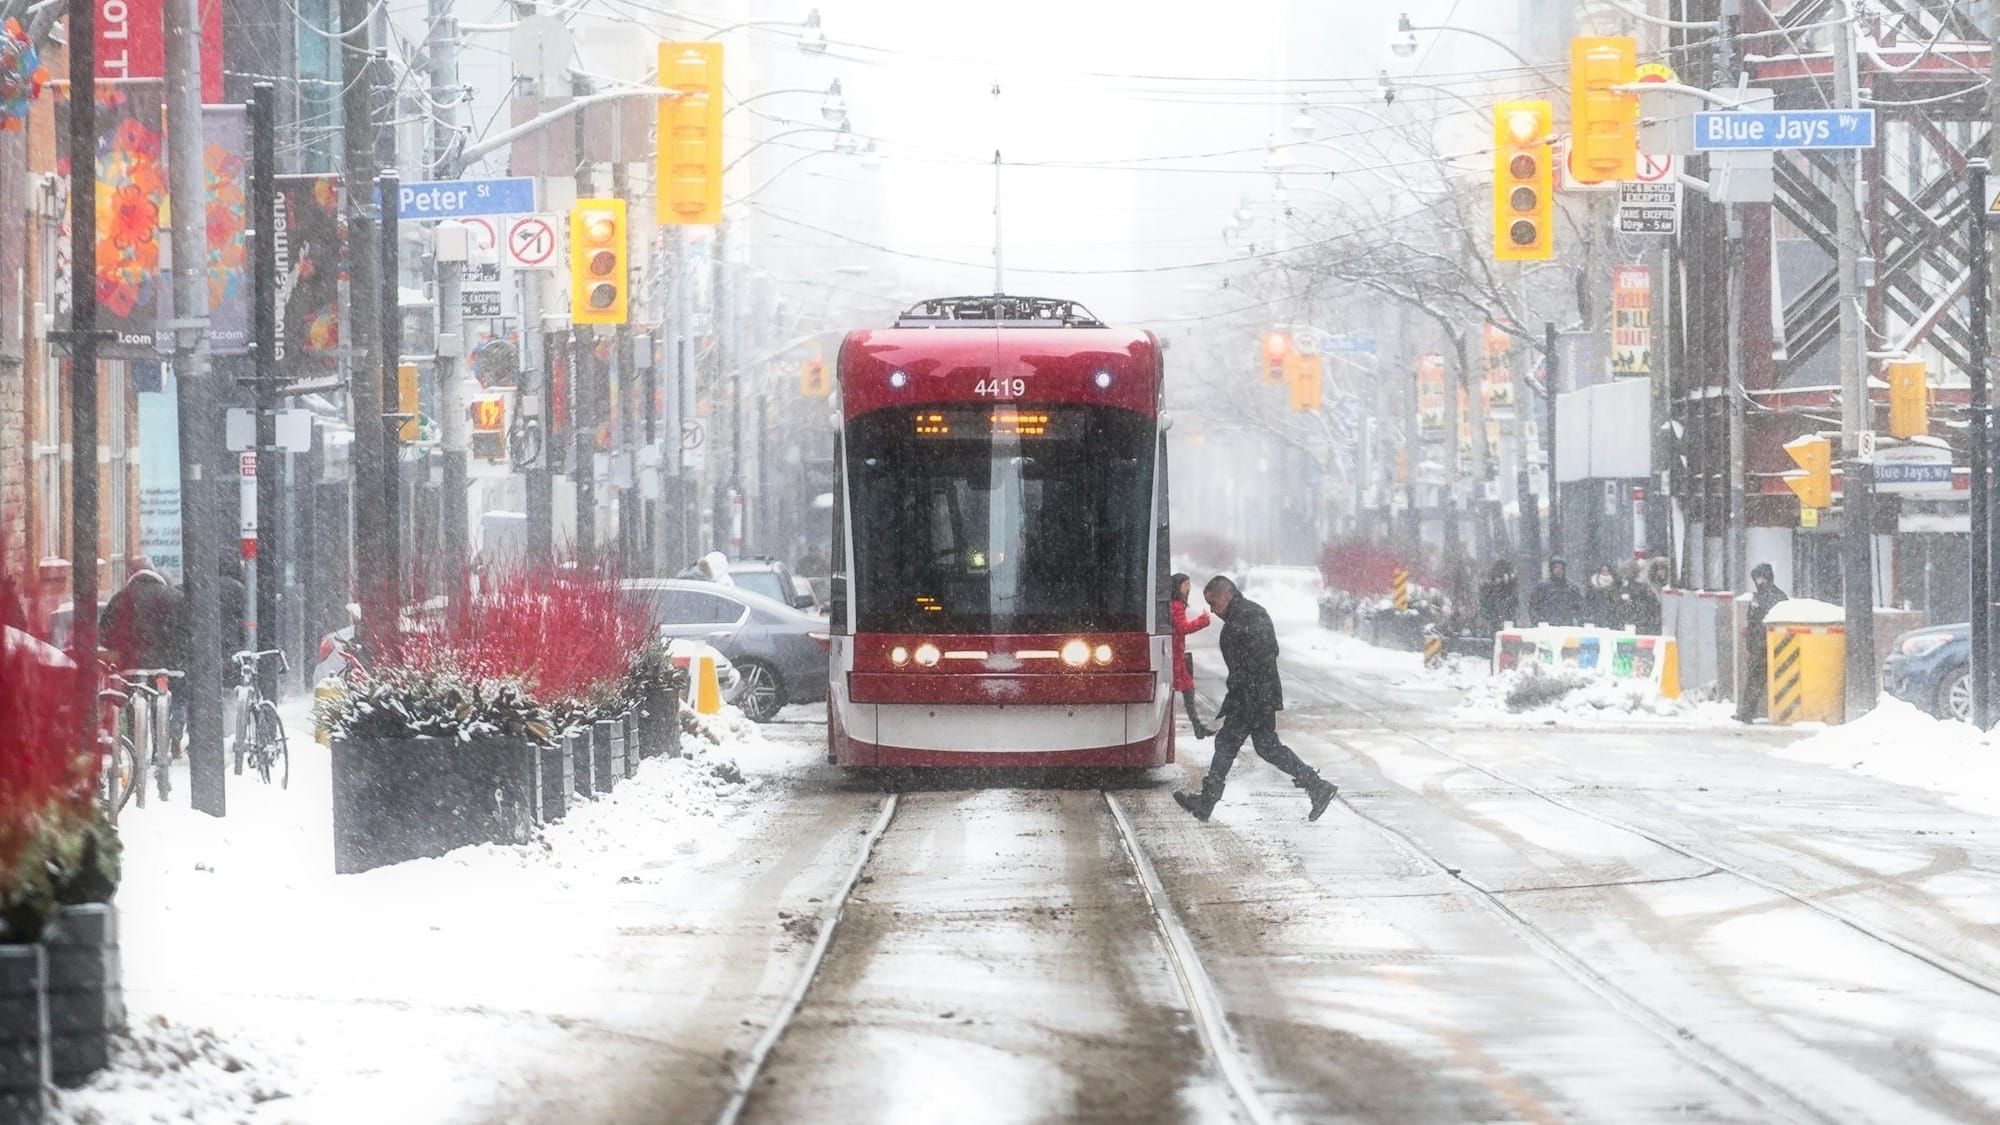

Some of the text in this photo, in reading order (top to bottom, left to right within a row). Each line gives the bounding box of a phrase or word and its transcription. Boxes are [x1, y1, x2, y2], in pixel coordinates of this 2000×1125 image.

[1708, 114, 1857, 145] Blue Jays Wy
[400, 184, 489, 212] Peter St
[975, 379, 1025, 396] 4419
[1873, 464, 1900, 479] Blue
